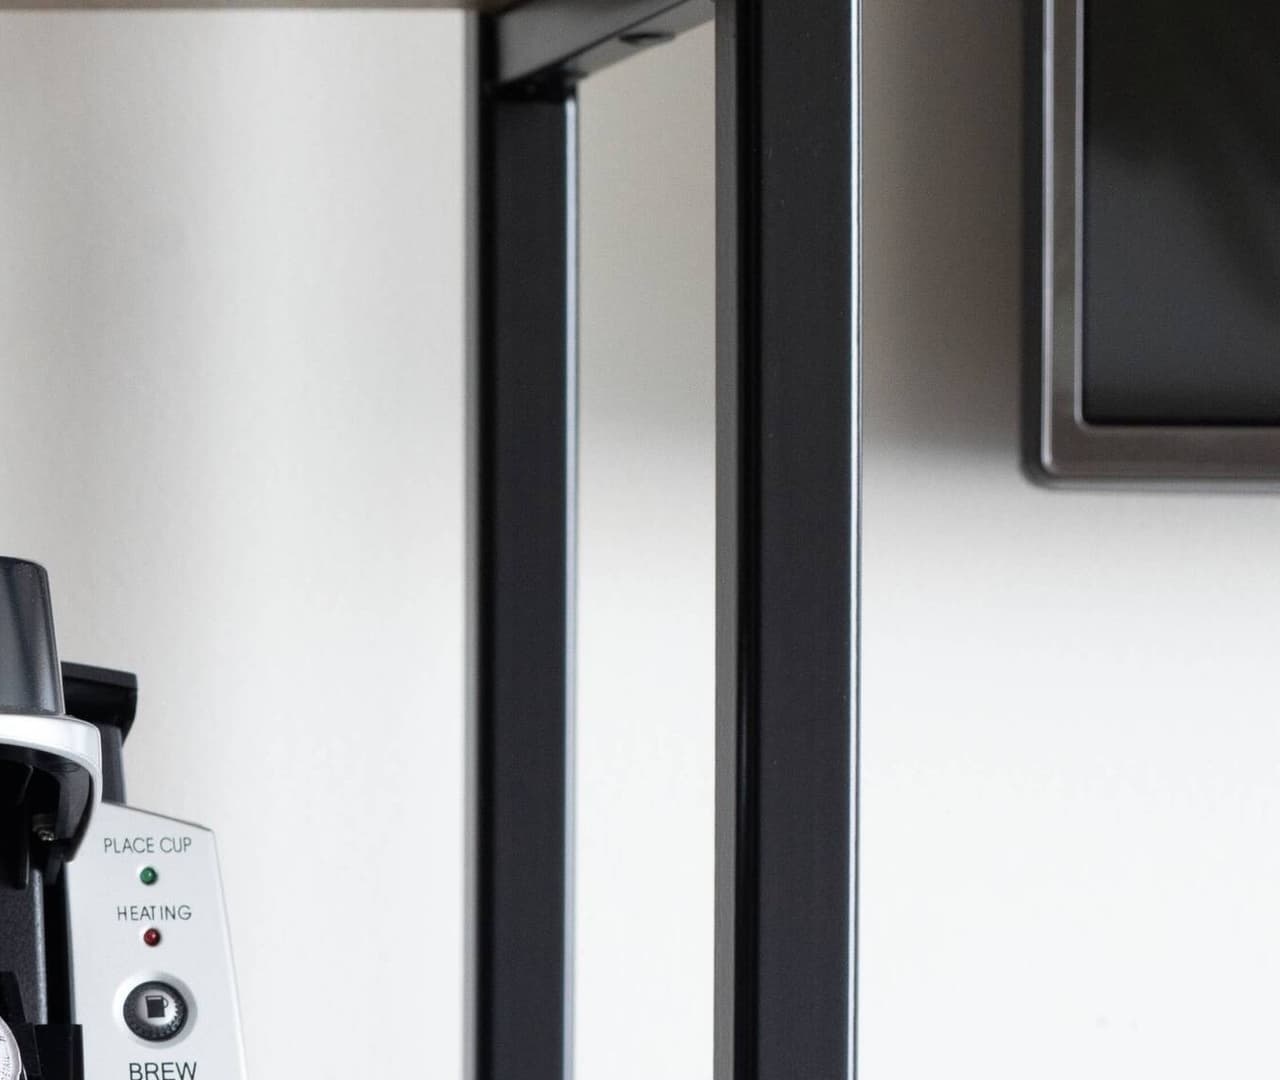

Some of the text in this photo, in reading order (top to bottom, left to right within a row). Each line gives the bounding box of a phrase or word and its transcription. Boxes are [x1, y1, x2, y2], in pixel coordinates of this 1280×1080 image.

[103, 836, 193, 854] PLACE CUP
[117, 905, 193, 921] HEATING
